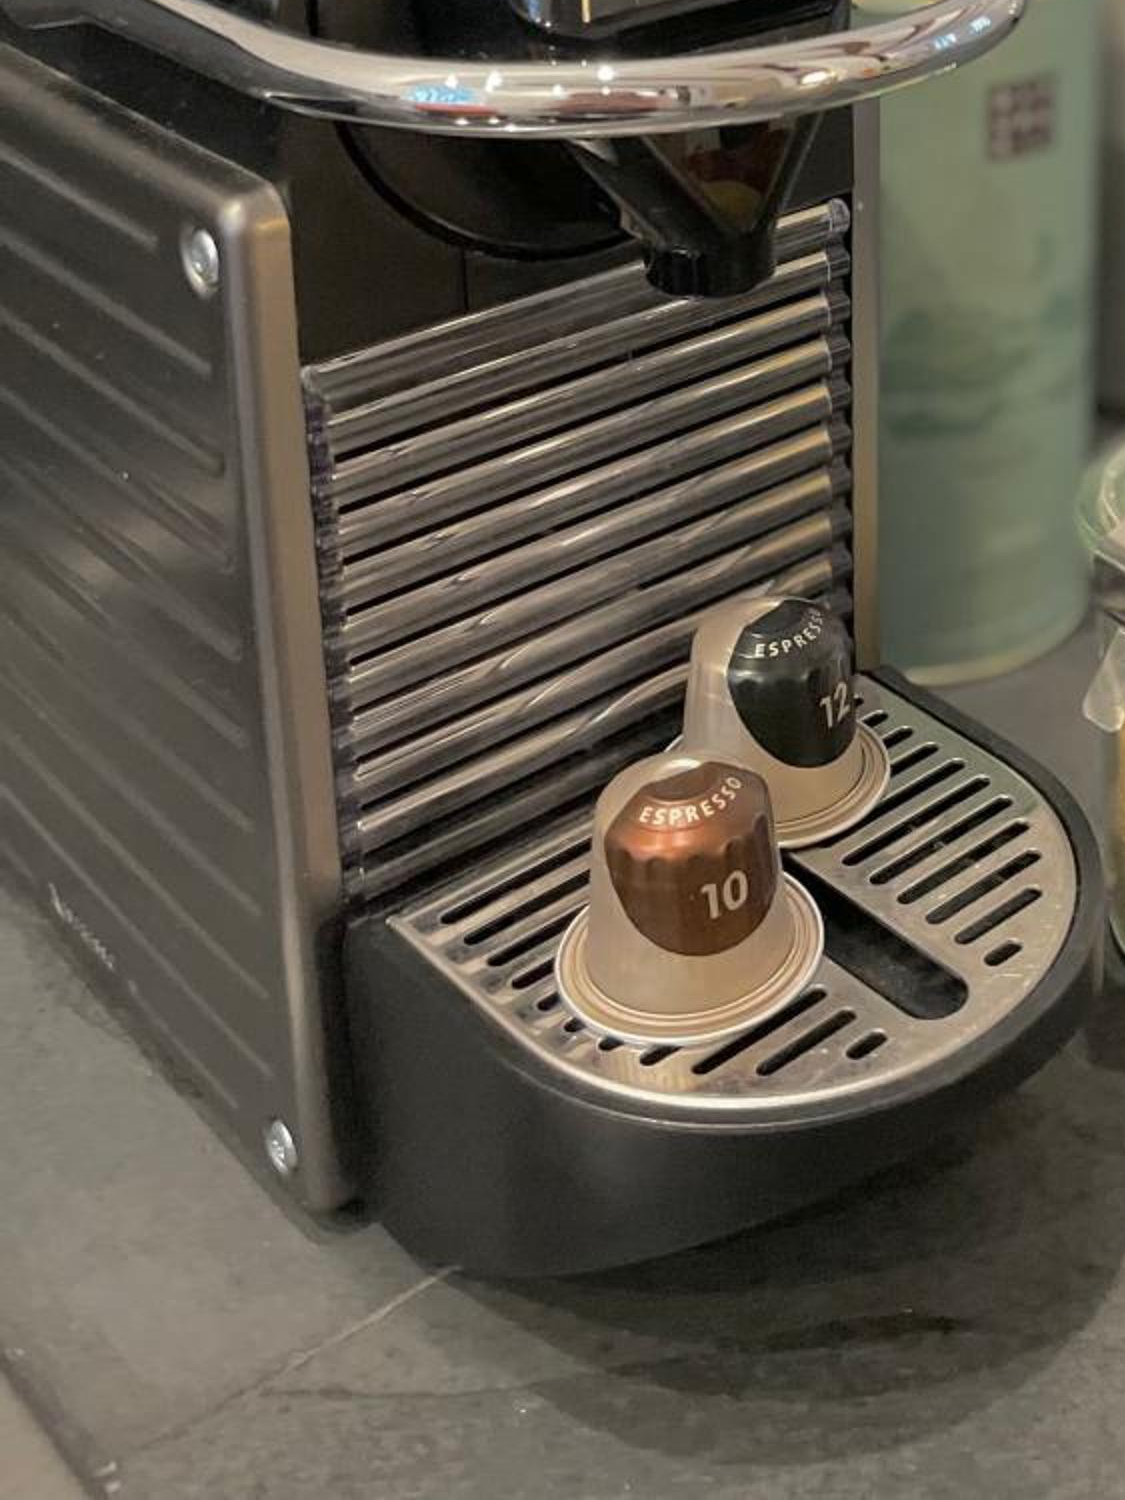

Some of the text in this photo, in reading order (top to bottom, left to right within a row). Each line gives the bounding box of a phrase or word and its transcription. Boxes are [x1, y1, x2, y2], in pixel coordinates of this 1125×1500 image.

[819, 681, 851, 729] 12
[639, 776, 742, 826] ESPRESSO
[701, 870, 748, 920] 10
